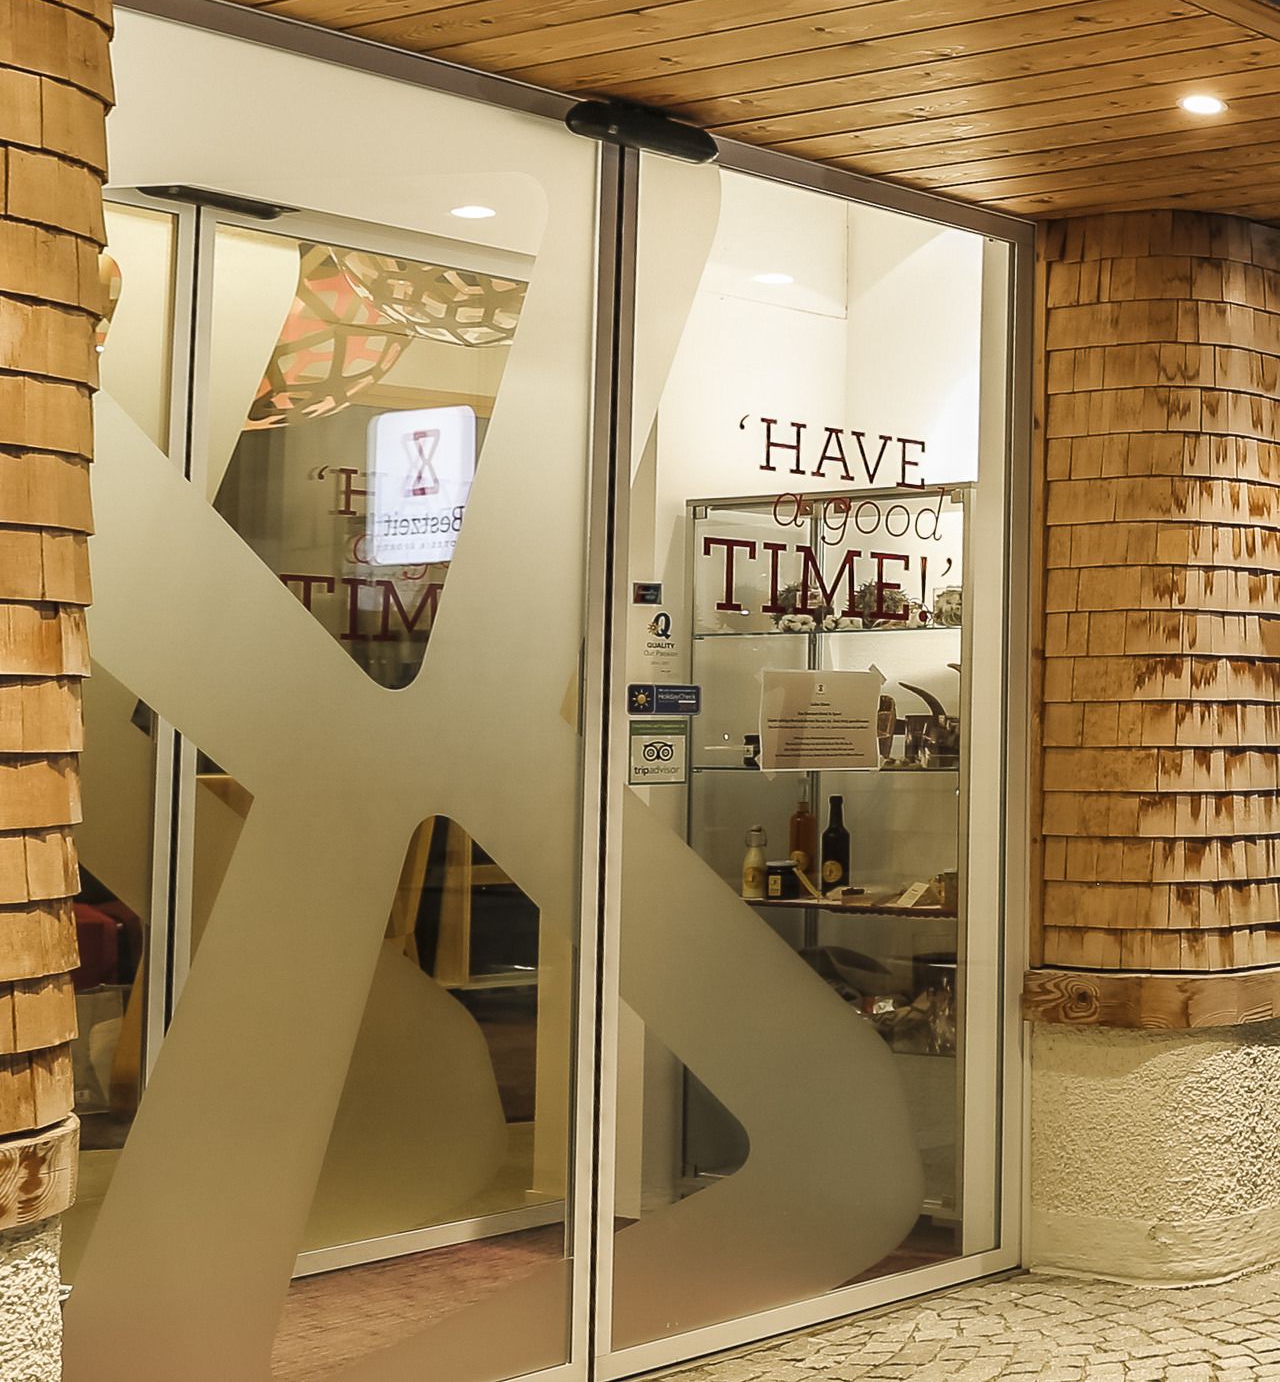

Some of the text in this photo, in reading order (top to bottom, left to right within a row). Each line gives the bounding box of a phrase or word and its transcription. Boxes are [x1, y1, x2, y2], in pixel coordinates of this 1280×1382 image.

[773, 486, 943, 546] a good
[634, 766, 680, 776] tripadvisor
